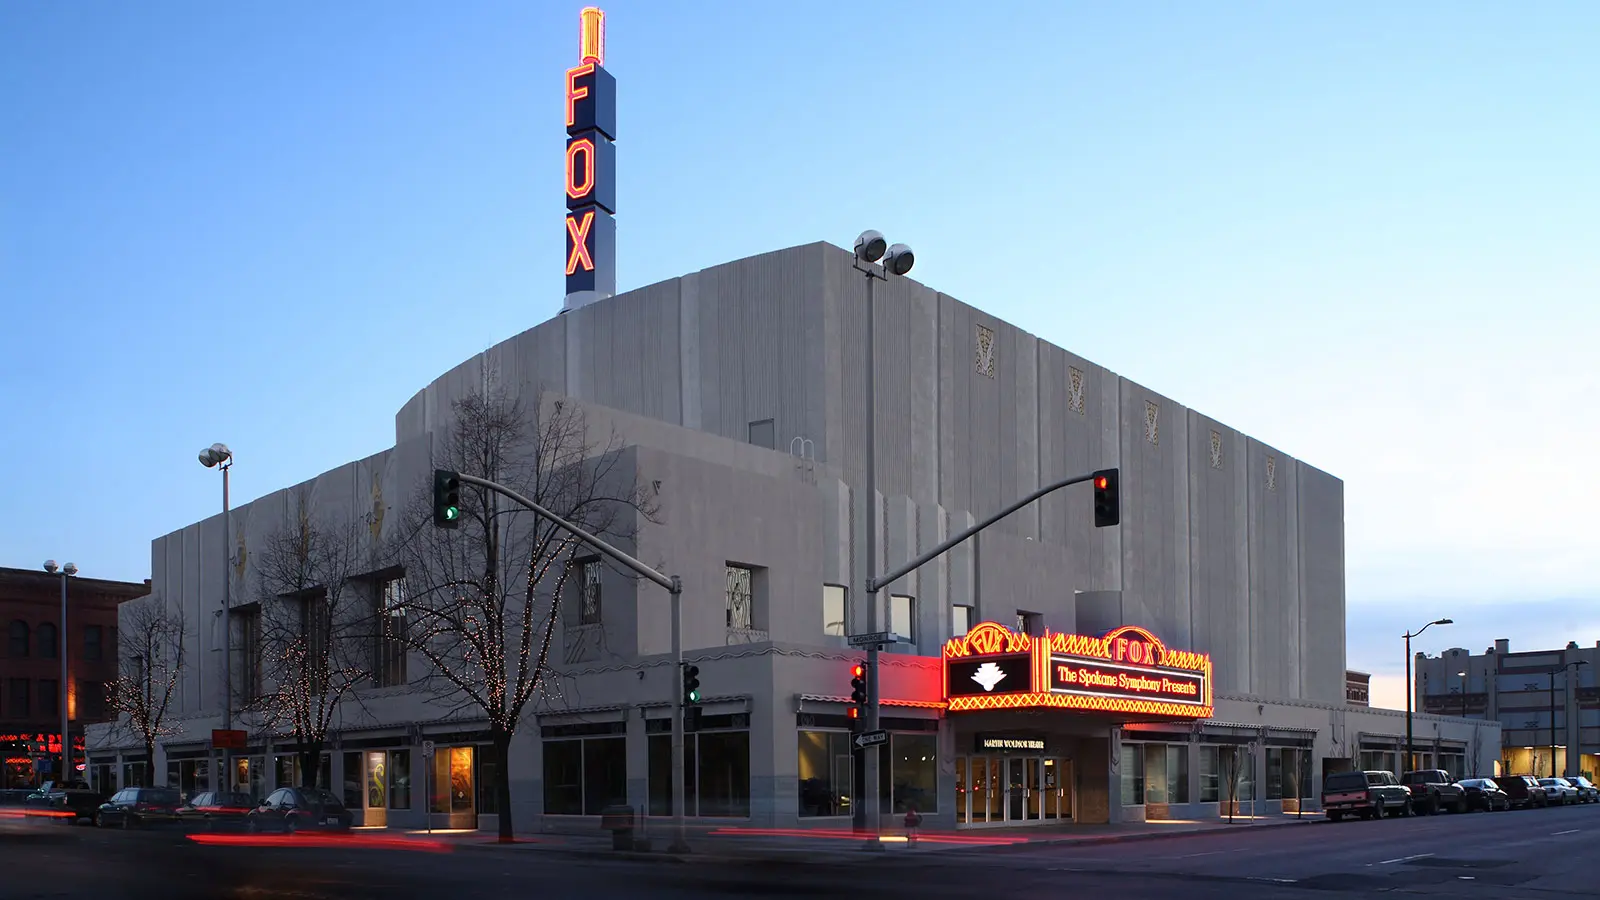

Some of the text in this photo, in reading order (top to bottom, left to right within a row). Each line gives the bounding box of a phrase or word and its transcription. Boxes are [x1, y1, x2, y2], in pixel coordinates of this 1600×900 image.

[565, 63, 595, 275] FOX
[970, 627, 1004, 654] FOX
[1114, 637, 1156, 666] FOX
[1057, 665, 1197, 695] The Spokane Symphony Presents
[861, 733, 885, 744] ONE WAY
